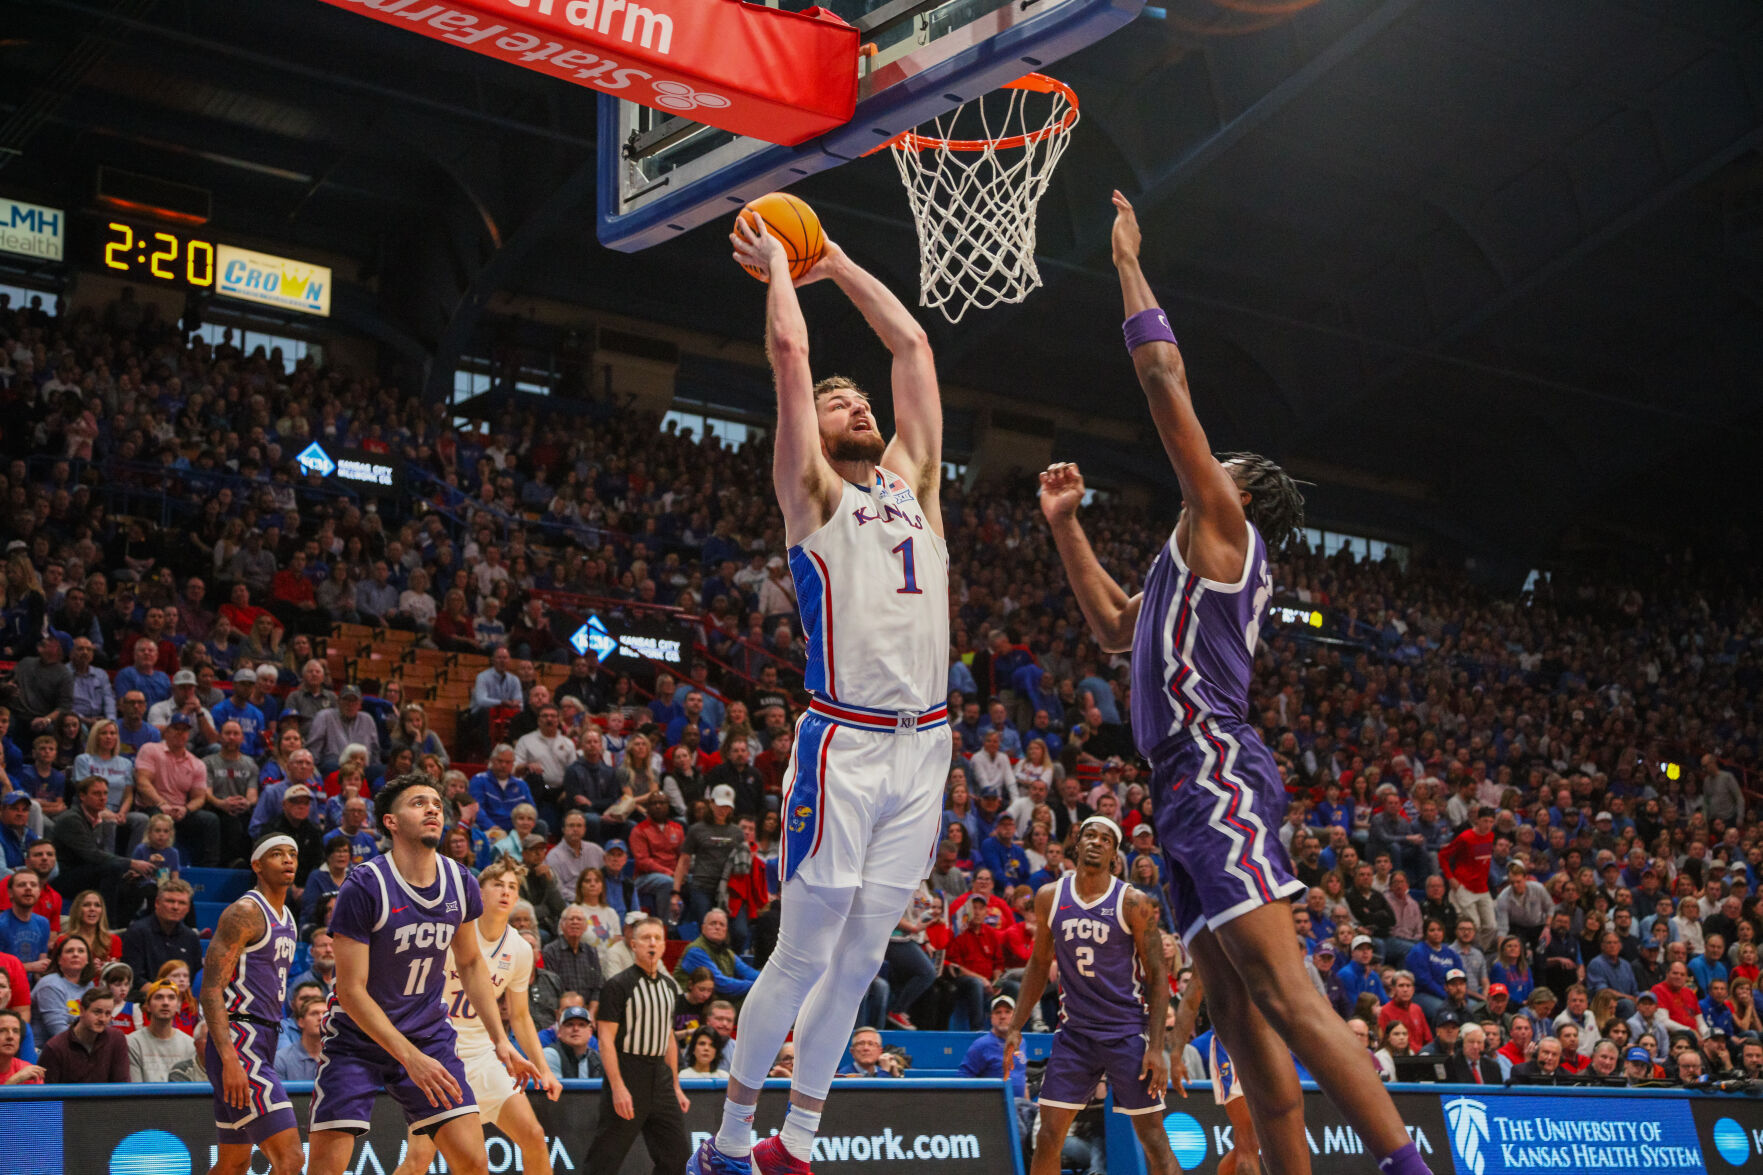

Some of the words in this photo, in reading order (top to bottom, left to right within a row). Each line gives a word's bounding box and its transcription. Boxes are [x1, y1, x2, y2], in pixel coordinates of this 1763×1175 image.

[0, 204, 58, 237] MH
[105, 222, 213, 287] 2:20
[892, 536, 923, 594] 1
[900, 717, 915, 729] KU
[394, 921, 456, 955] TCU
[1061, 918, 1111, 945] TCU
[273, 936, 297, 963] TCU
[1075, 946, 1095, 978] 2
[278, 966, 287, 1002] 3
[403, 957, 433, 996] 11
[1493, 1117, 1535, 1141] THE
[1535, 1118, 1637, 1142] UNIVERSITY
[1639, 1122, 1662, 1142] OF
[1501, 1144, 1571, 1167] KANSAS
[1572, 1144, 1641, 1167] HEALTH
[1641, 1145, 1702, 1167] SYSTEM
